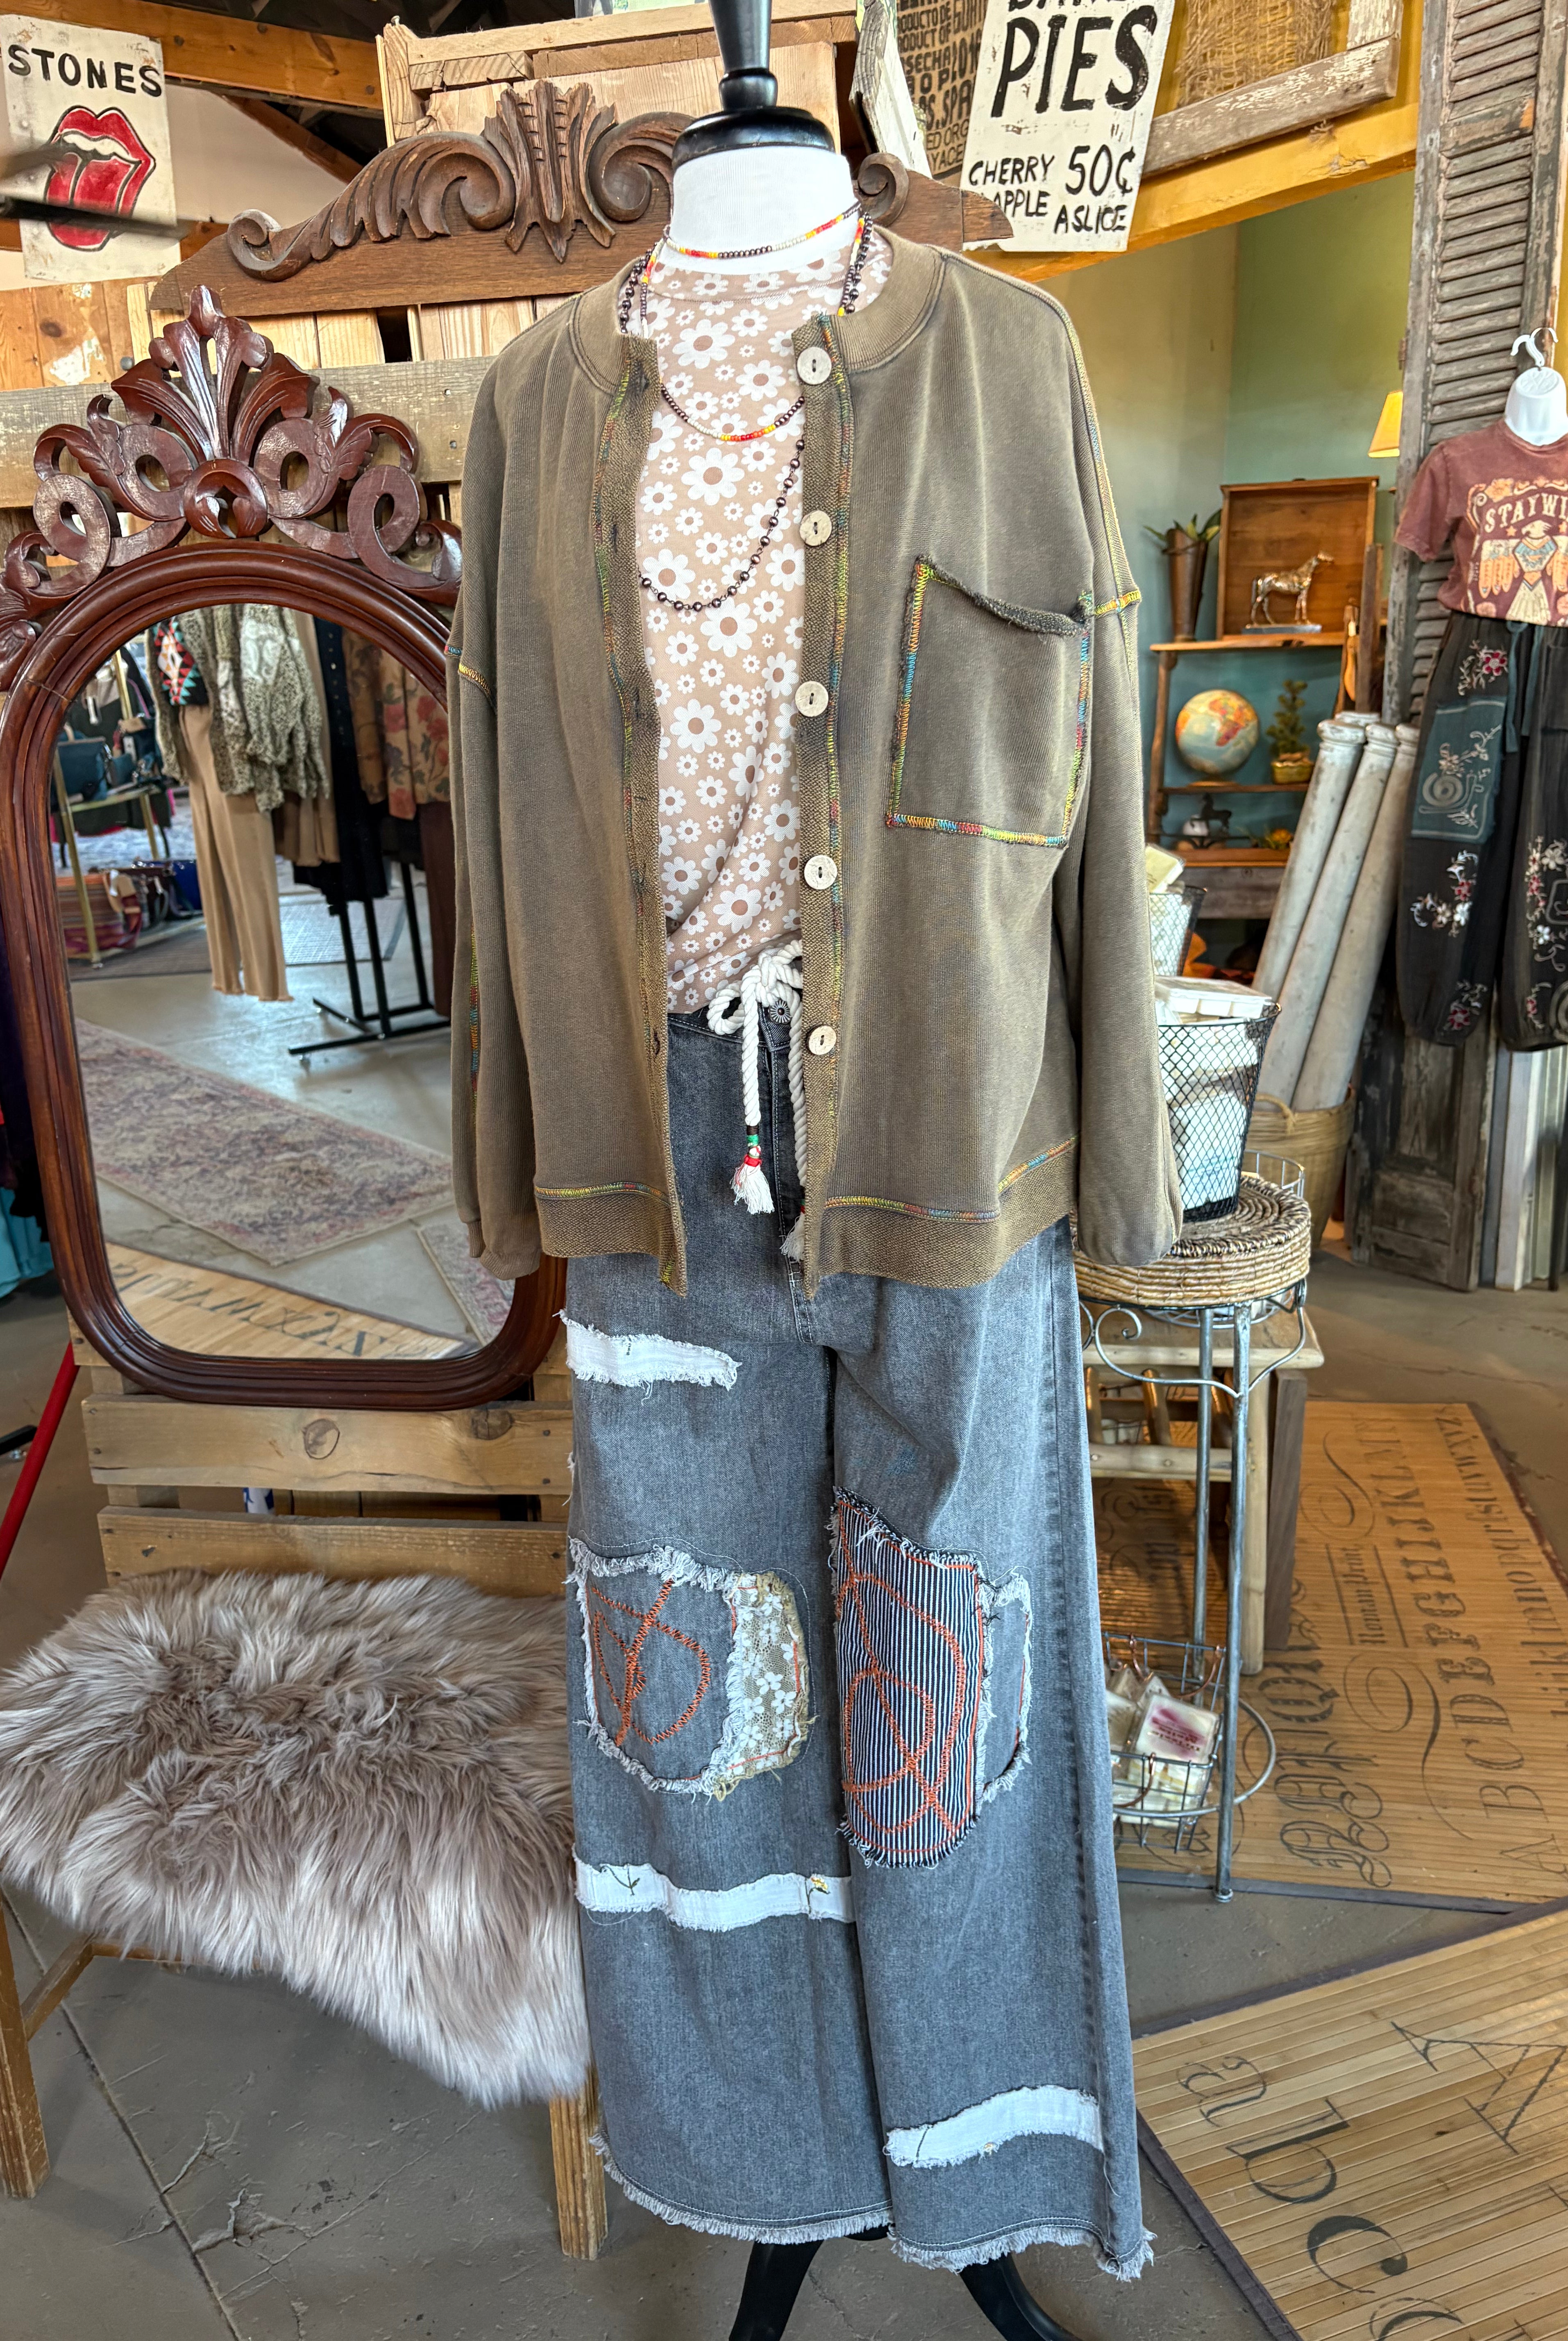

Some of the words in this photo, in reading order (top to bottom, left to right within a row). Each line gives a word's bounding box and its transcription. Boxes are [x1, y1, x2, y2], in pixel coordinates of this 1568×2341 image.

[939, 22, 951, 45] OF
[8, 44, 161, 97] STONES
[991, 5, 1157, 118] PIES
[969, 154, 1055, 185] CHERRY
